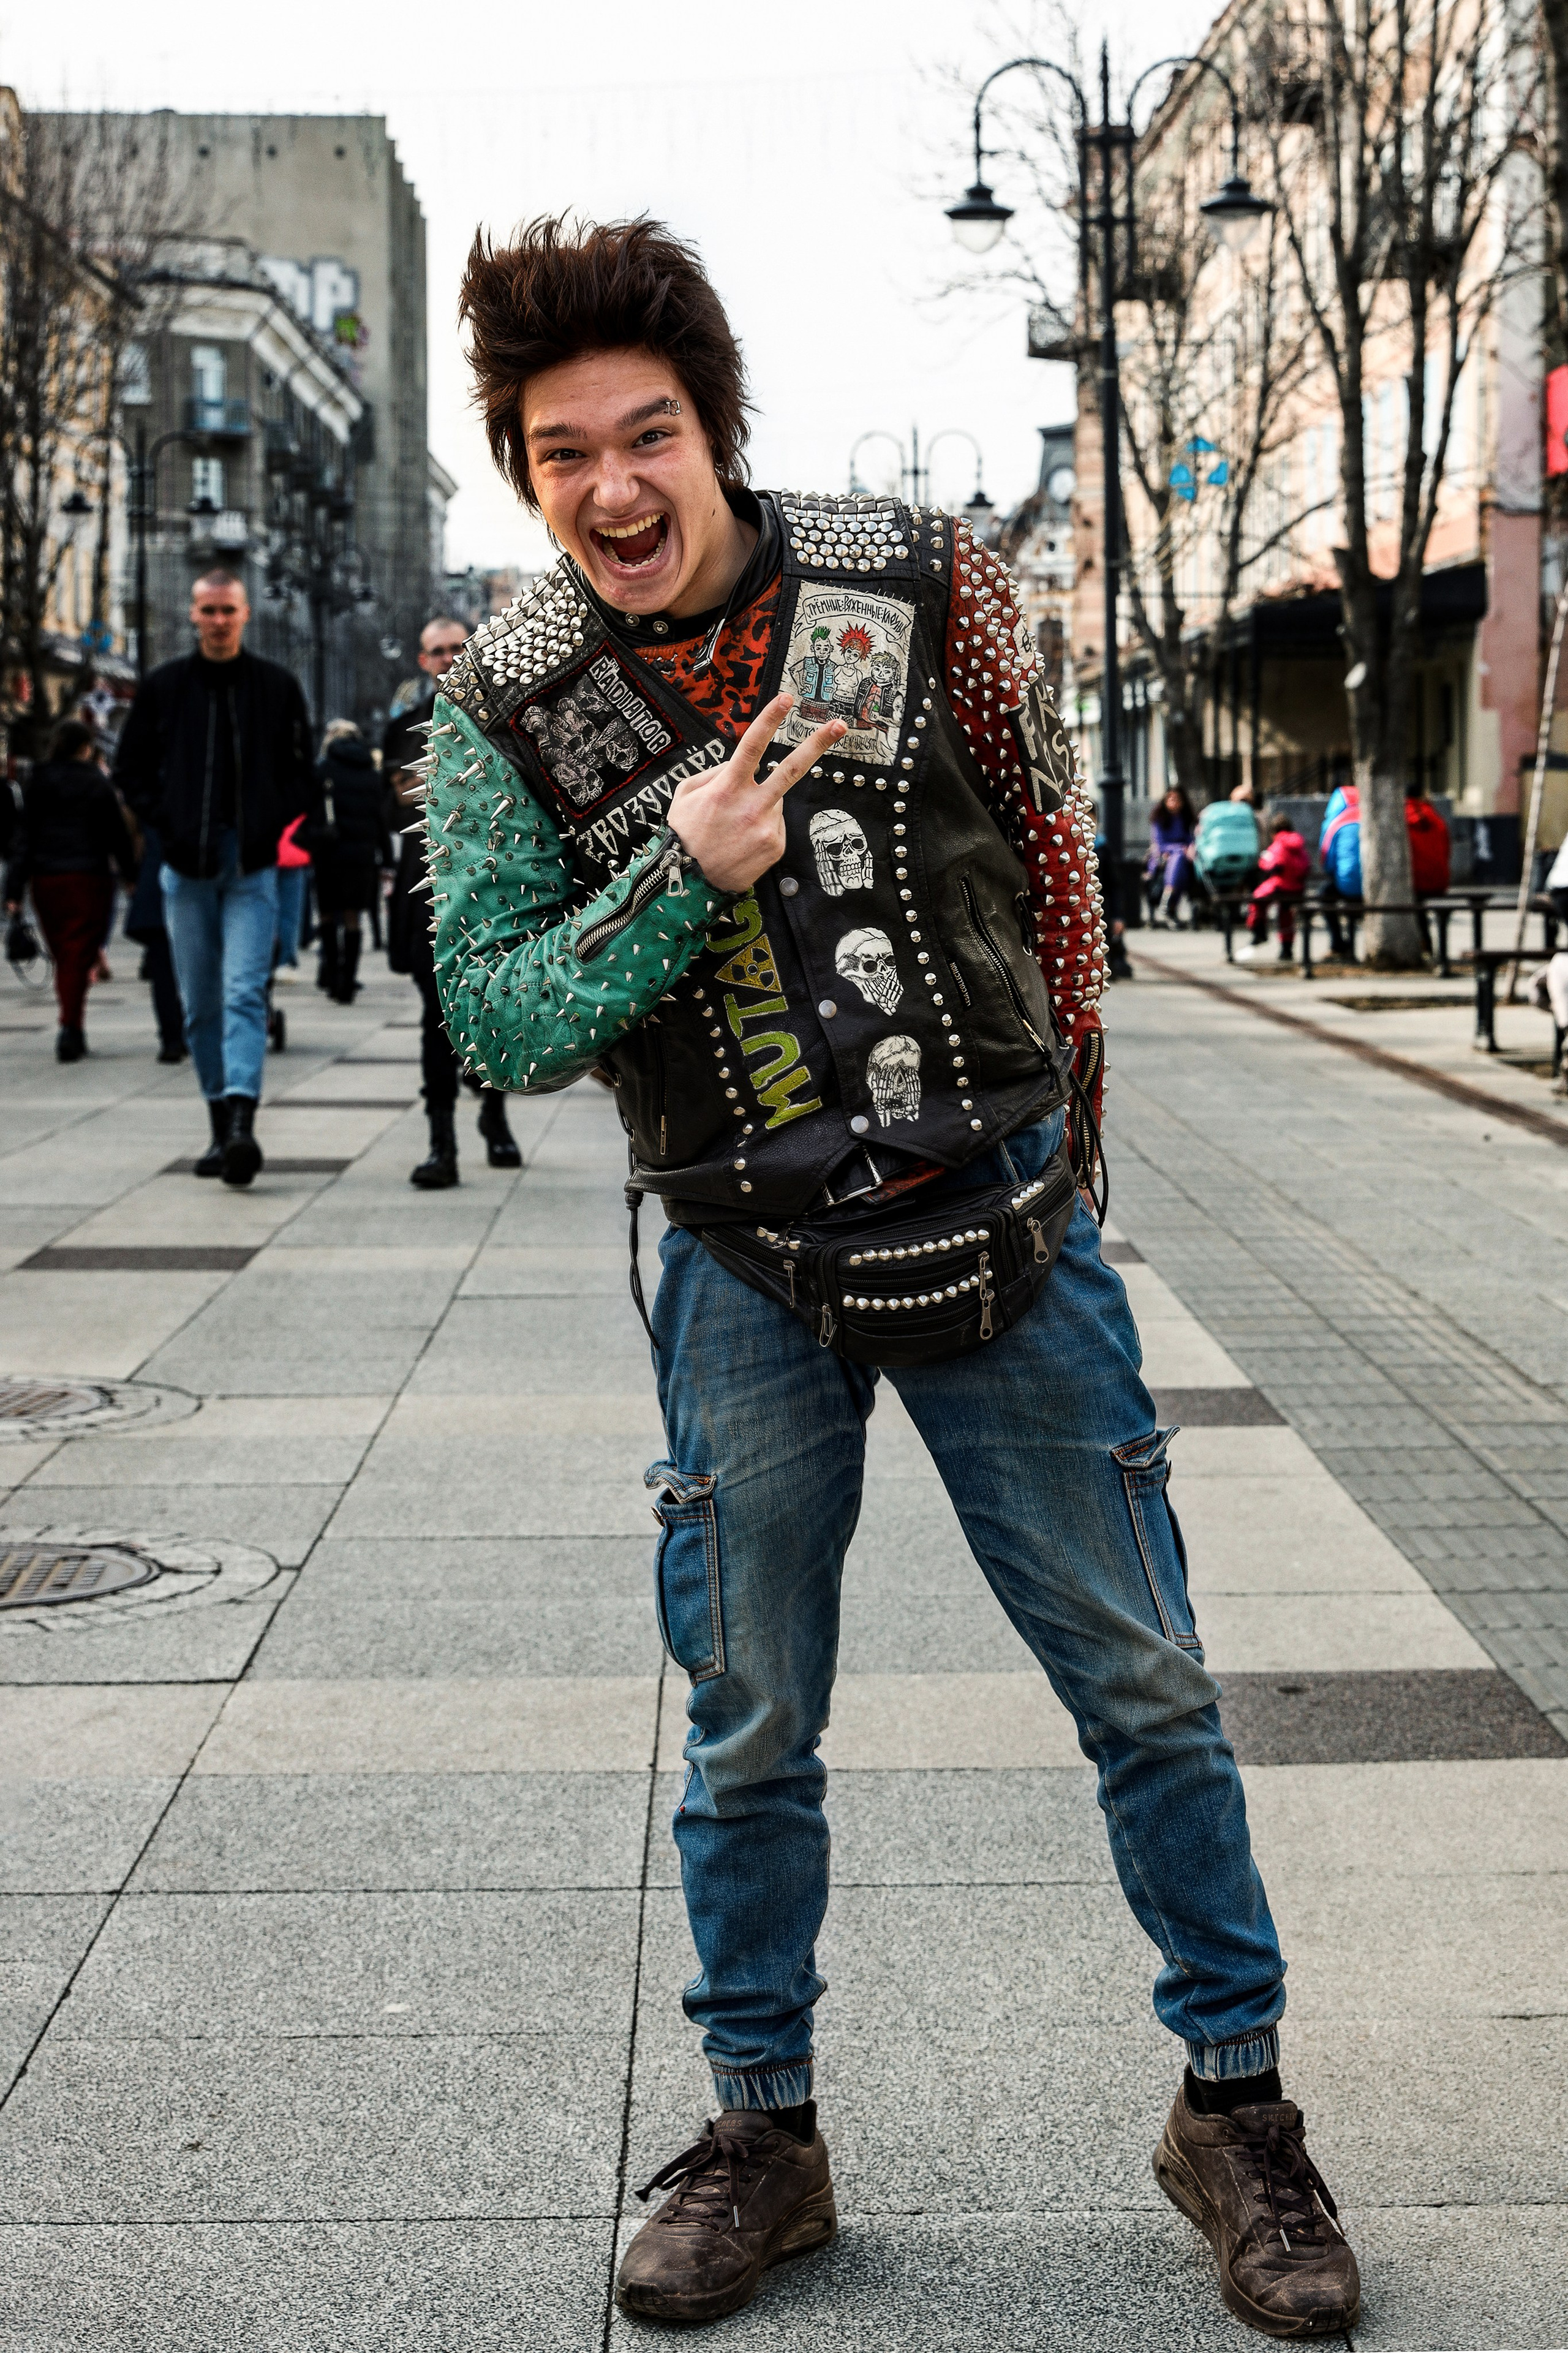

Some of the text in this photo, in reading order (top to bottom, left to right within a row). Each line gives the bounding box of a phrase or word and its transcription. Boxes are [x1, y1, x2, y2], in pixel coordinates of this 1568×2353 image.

[589, 655, 671, 755] RADIATOR
[705, 885, 823, 1130] MUTAG
[949, 962, 967, 993] COLLECTION
